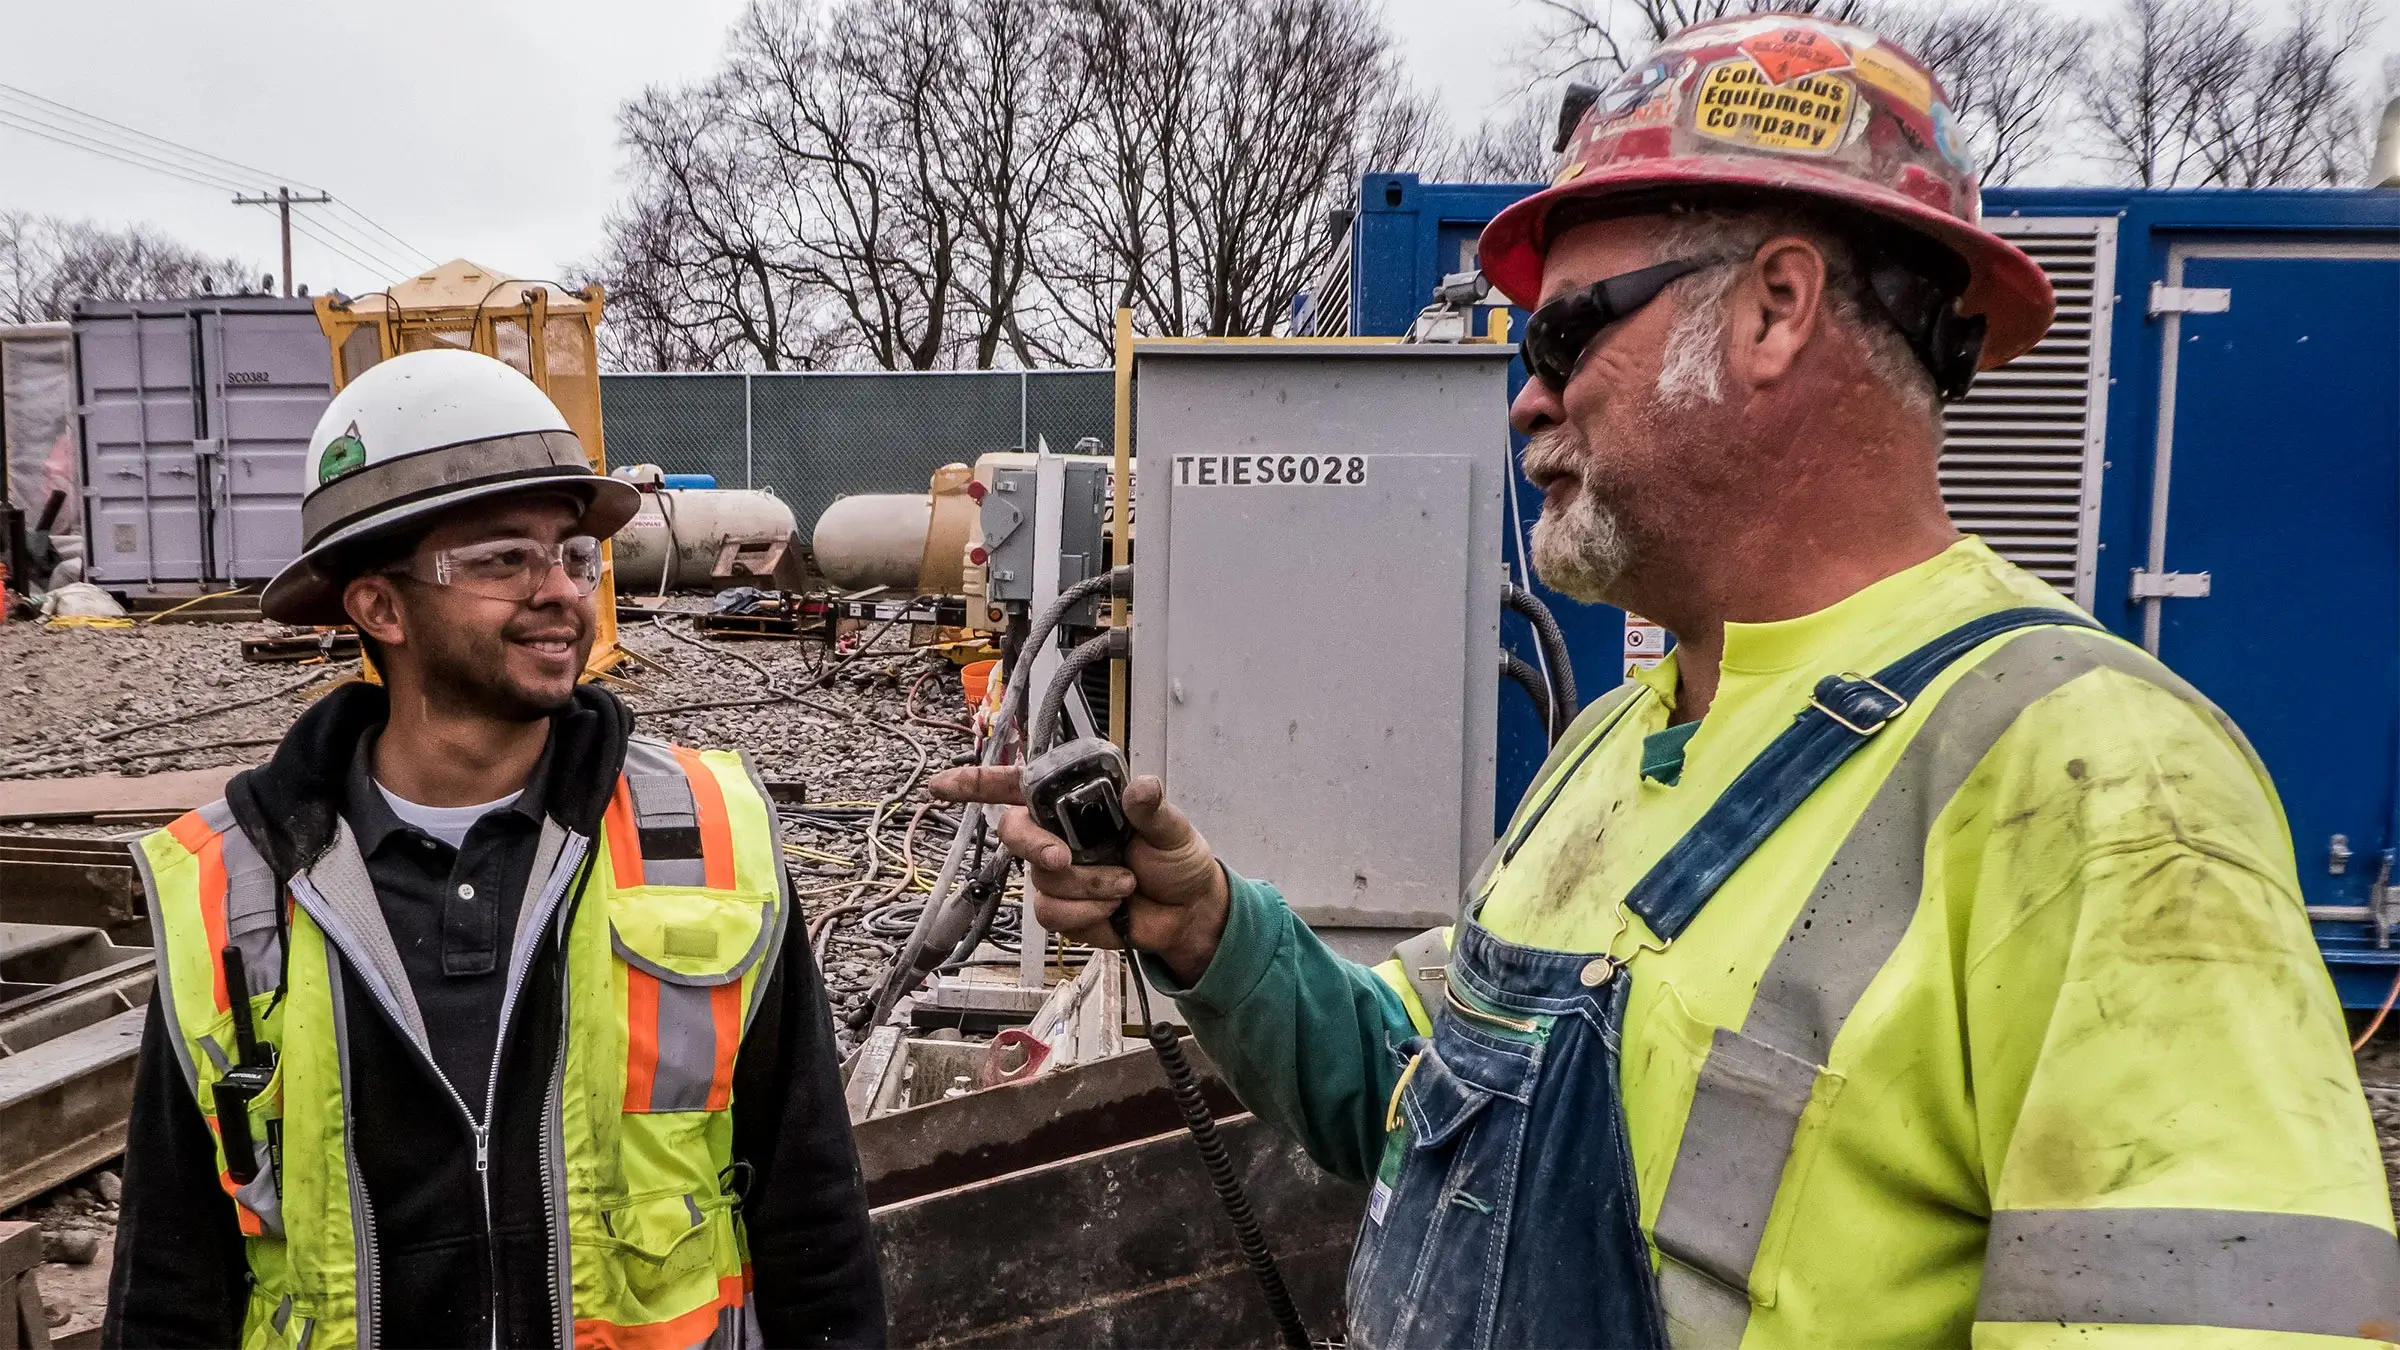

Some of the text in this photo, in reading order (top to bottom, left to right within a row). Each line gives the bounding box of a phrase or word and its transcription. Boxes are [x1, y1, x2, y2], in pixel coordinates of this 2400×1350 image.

[1715, 66, 1844, 101] Colbus
[1704, 85, 1841, 123] Equipment
[1706, 107, 1827, 145] Company
[1176, 455, 1366, 485] TEIESG028
